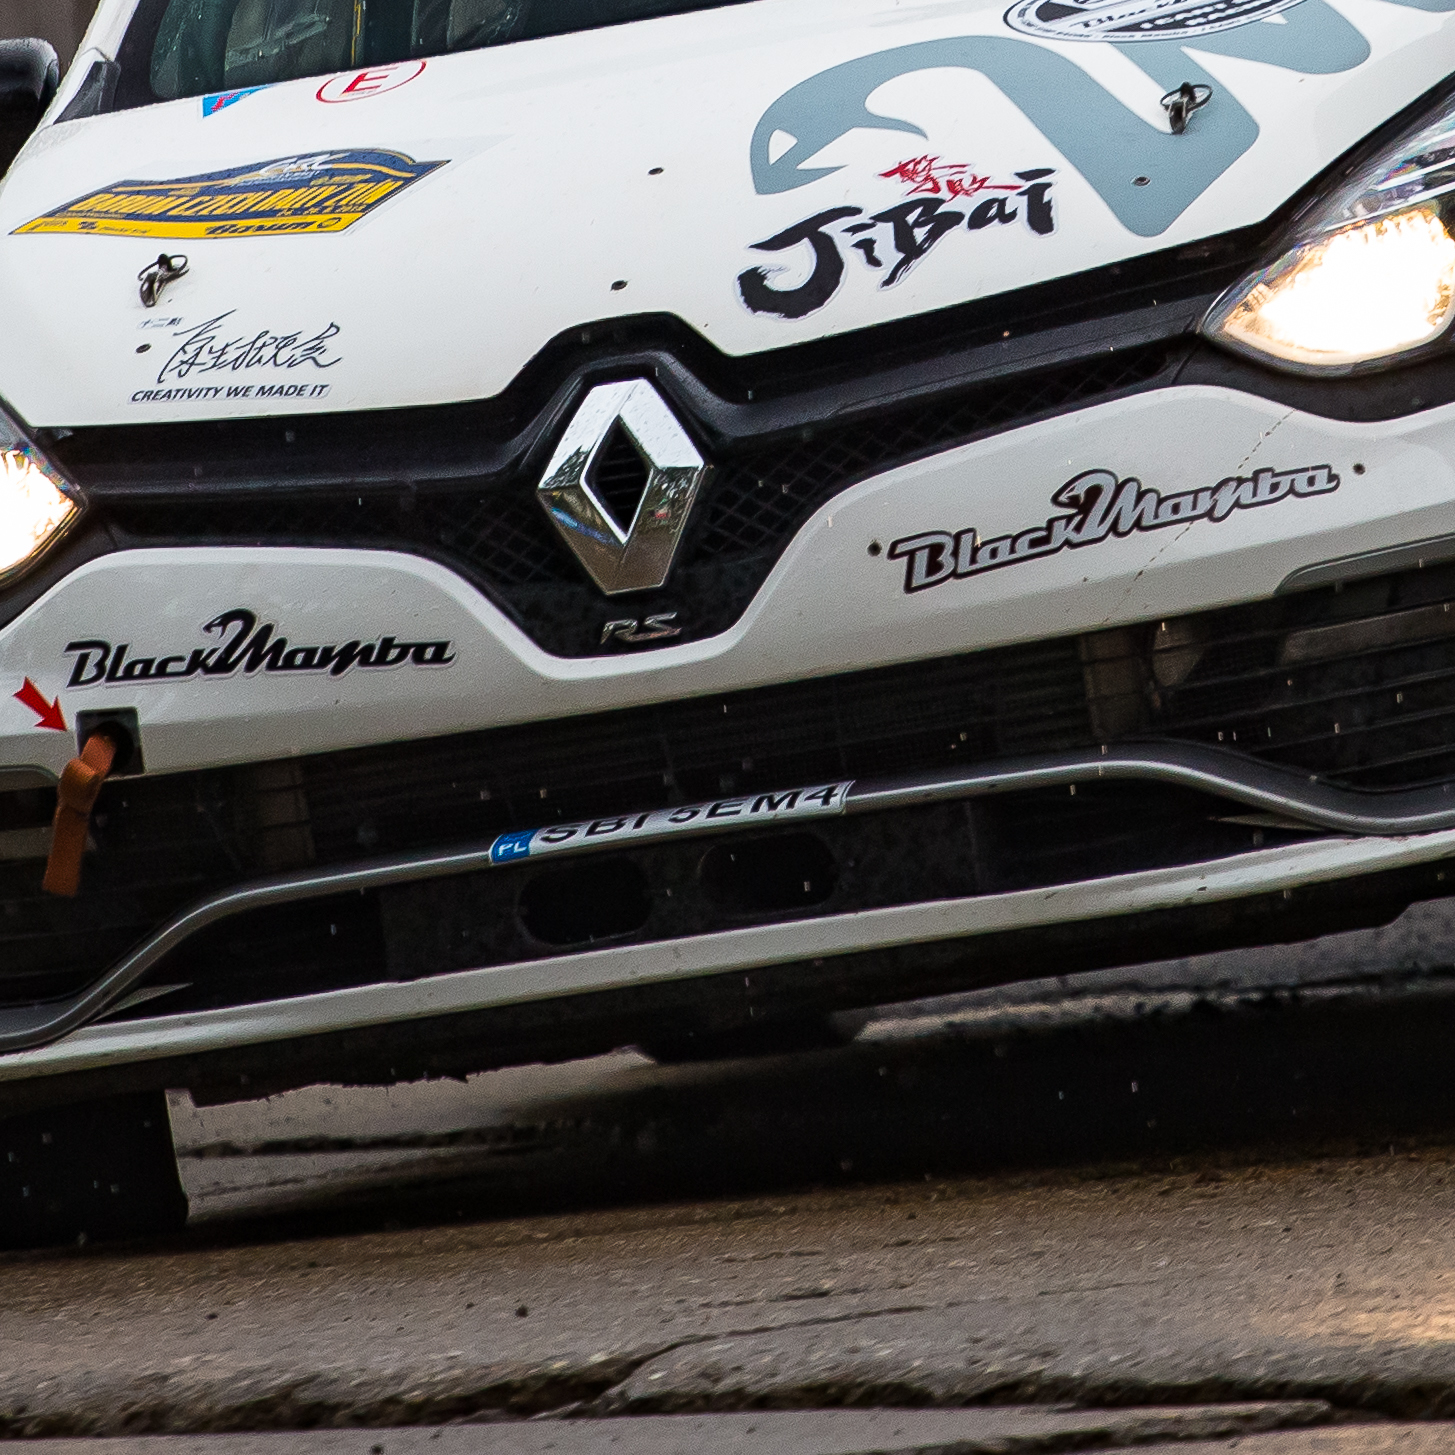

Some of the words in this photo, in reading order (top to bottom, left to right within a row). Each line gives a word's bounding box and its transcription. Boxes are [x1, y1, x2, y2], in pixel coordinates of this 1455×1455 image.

[341, 65, 399, 96] E
[737, 168, 1057, 319] JiBai
[130, 386, 224, 403] CREATIVITY
[226, 385, 255, 398] WE
[255, 384, 309, 398] MADE
[310, 383, 330, 397] IT
[888, 464, 1342, 594] BlackMamba
[599, 610, 683, 646] RS
[64, 607, 457, 687] BlackMamba
[497, 840, 531, 857] PL
